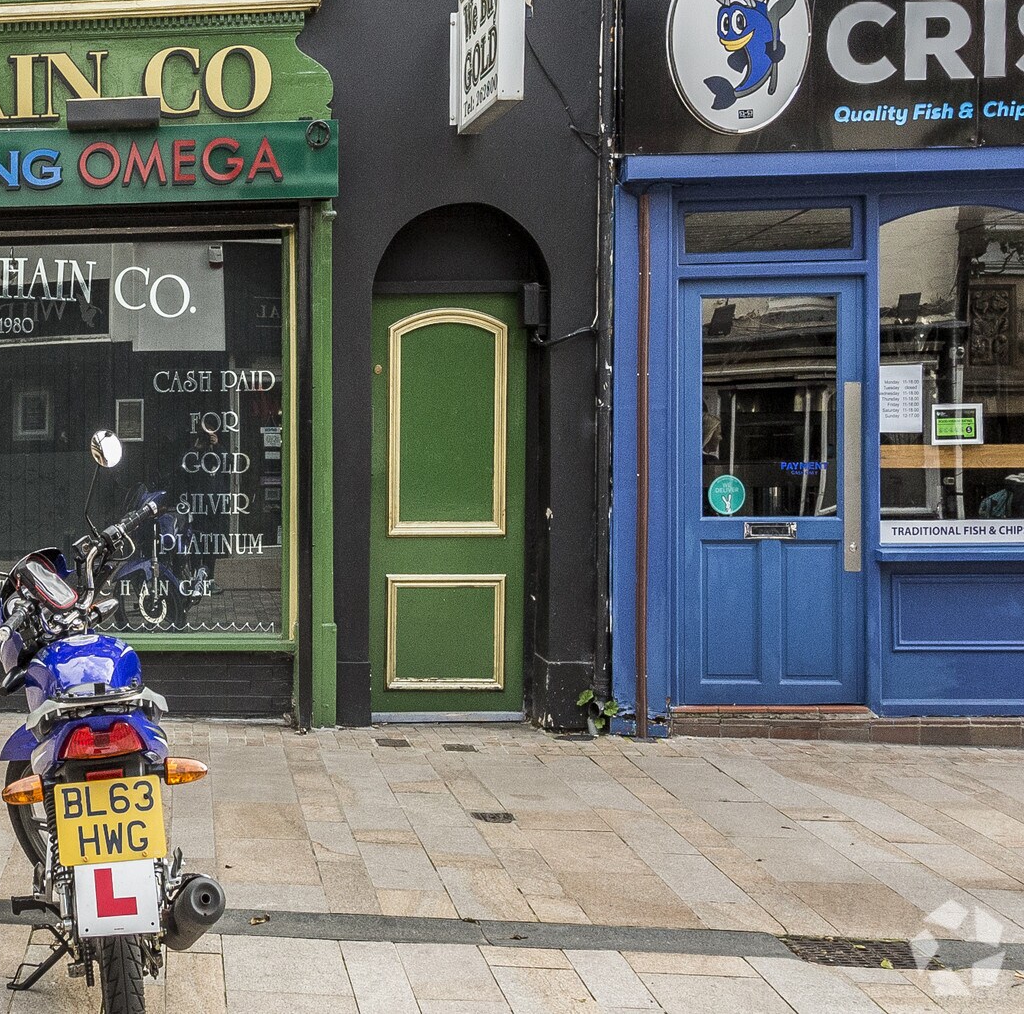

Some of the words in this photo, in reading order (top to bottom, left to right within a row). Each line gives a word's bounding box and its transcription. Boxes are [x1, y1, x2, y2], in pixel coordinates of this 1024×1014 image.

[464, 26, 498, 95] GOLD
[144, 45, 273, 116] CO
[463, 95, 475, 118] Tel:
[834, 103, 908, 126] Quality
[912, 102, 954, 120] Fish
[955, 103, 973, 119] &
[78, 136, 283, 188] OMEGA
[114, 266, 197, 318] CO.
[153, 370, 212, 393] CASH
[220, 370, 276, 392] PAID
[189, 411, 240, 434] FOR
[181, 452, 251, 474] GOLD
[780, 461, 829, 470] PAYMENT
[176, 492, 251, 516] SILVER
[892, 526, 961, 536] TRADITIONAL
[964, 526, 985, 535] FISH
[988, 526, 997, 535] &
[999, 525, 1024, 535] CHIP
[158, 533, 264, 556] PLATINUM
[61, 780, 155, 820] BL63
[77, 819, 149, 858] HWG
[93, 868, 138, 918] L
